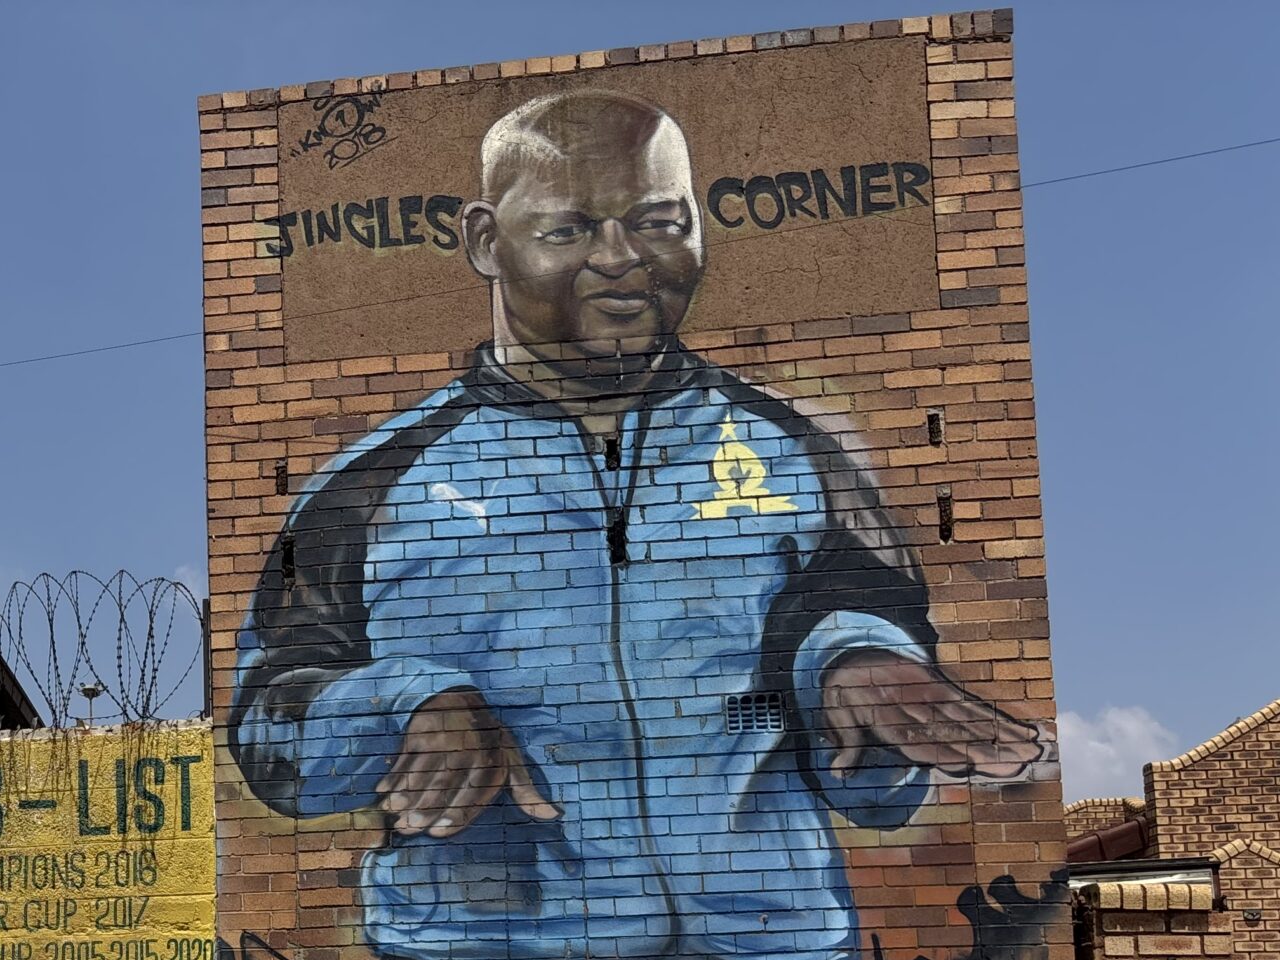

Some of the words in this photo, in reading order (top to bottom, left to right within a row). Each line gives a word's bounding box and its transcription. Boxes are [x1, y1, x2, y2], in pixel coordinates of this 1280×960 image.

[264, 195, 463, 257] JINGLES
[707, 162, 931, 230] CORNER
[77, 755, 202, 837] LIST
[94, 849, 158, 889] 2016
[23, 898, 78, 933] CUP
